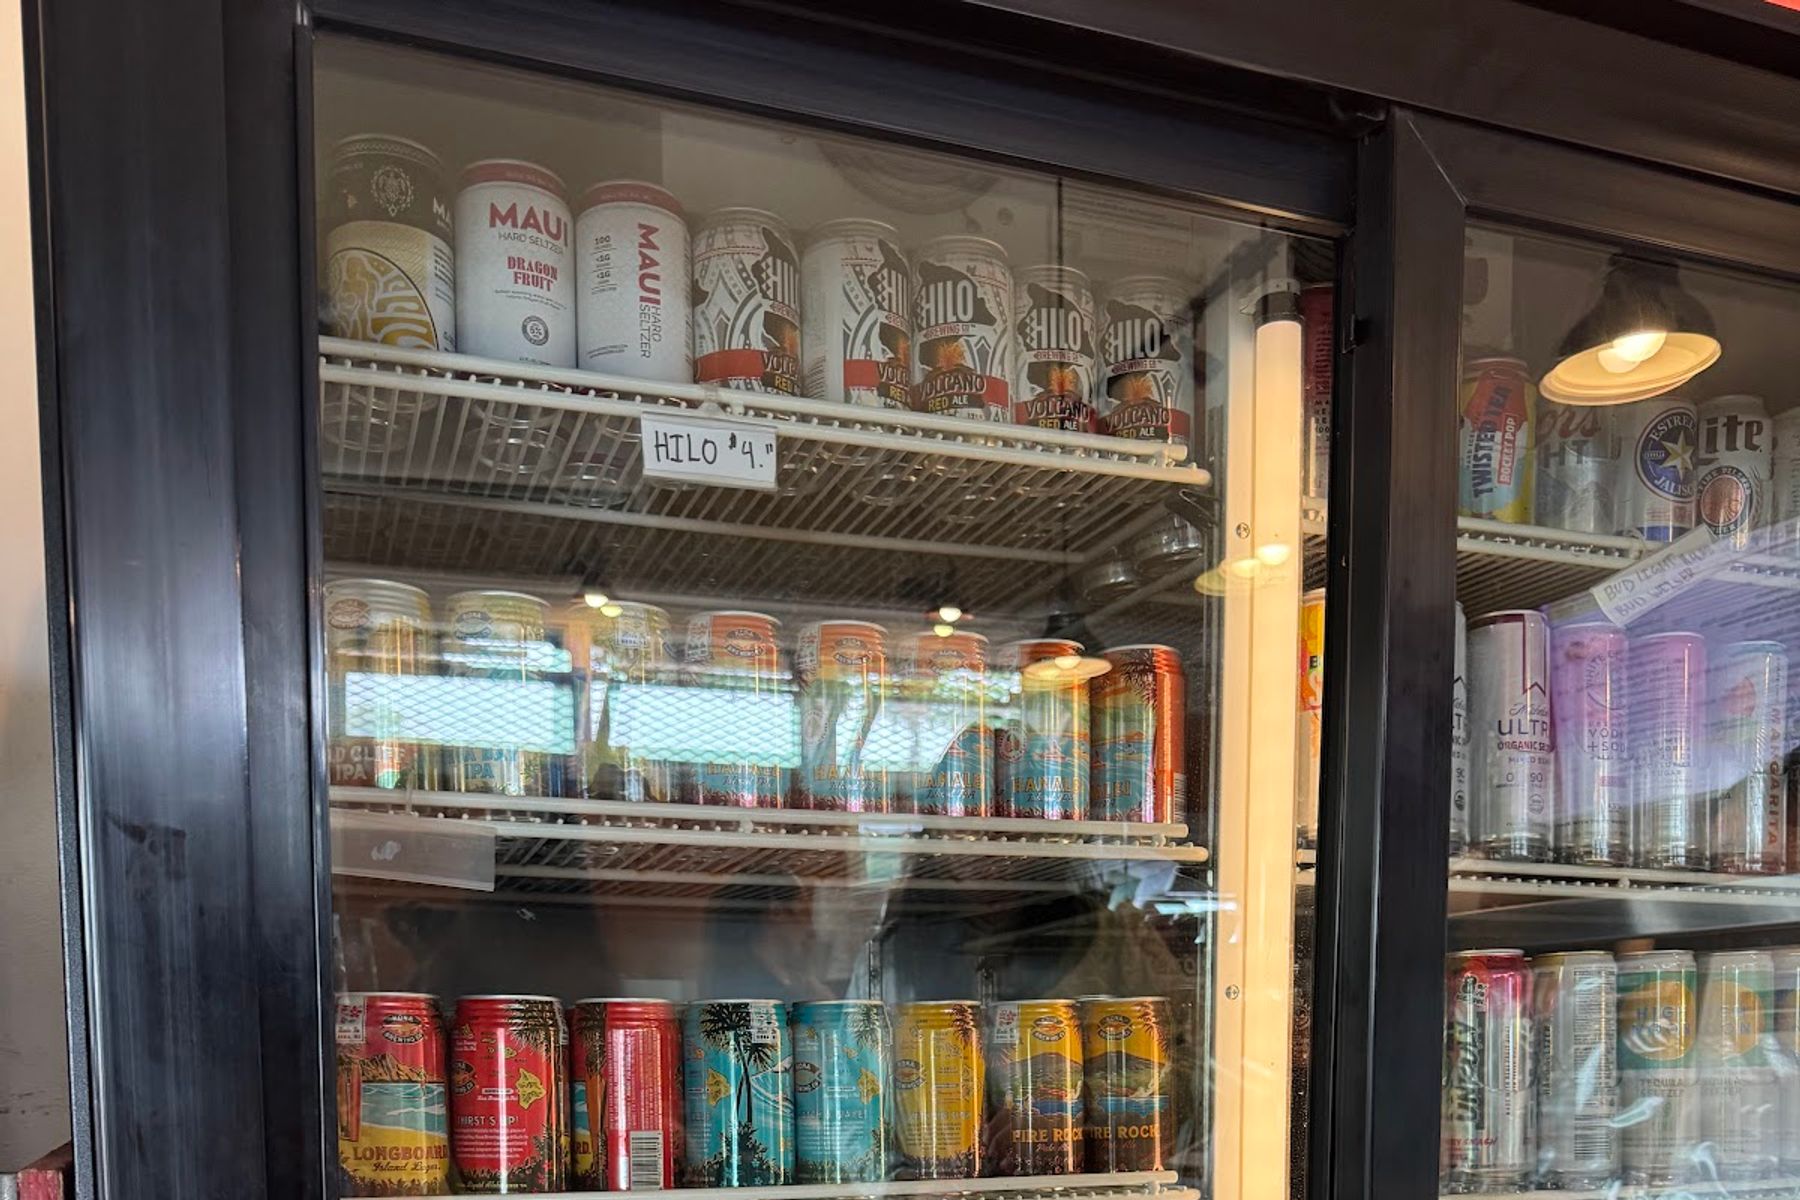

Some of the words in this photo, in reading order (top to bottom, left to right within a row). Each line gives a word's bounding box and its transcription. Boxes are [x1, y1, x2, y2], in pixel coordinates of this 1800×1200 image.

[489, 202, 569, 247] MAUI
[507, 256, 558, 279] DRAGON
[637, 222, 661, 306] MAUI
[513, 271, 554, 292] FRUIT
[917, 279, 975, 328] HILO
[639, 304, 651, 359] SELTZER
[1024, 307, 1082, 350] HILO
[1104, 317, 1162, 364] HILO
[919, 372, 987, 401] VOLCANO
[928, 397, 949, 412] RED
[952, 394, 969, 406] ALE
[1025, 399, 1091, 423] VOLCANO
[1039, 418, 1060, 430] RED
[1063, 420, 1078, 431] ALE
[1105, 406, 1172, 433] VOLCANO
[1140, 426, 1156, 437] ALE
[1504, 416, 1517, 440] POP
[654, 430, 717, 465] HILO
[1471, 419, 1497, 499] TWISTED
[1499, 440, 1515, 484] ROCKET
[1603, 578, 1637, 602] BUD
[1613, 594, 1648, 617] BUD
[336, 764, 367, 781] IPA
[1011, 1128, 1049, 1143] FIRE
[1117, 1123, 1161, 1139] ROCK
